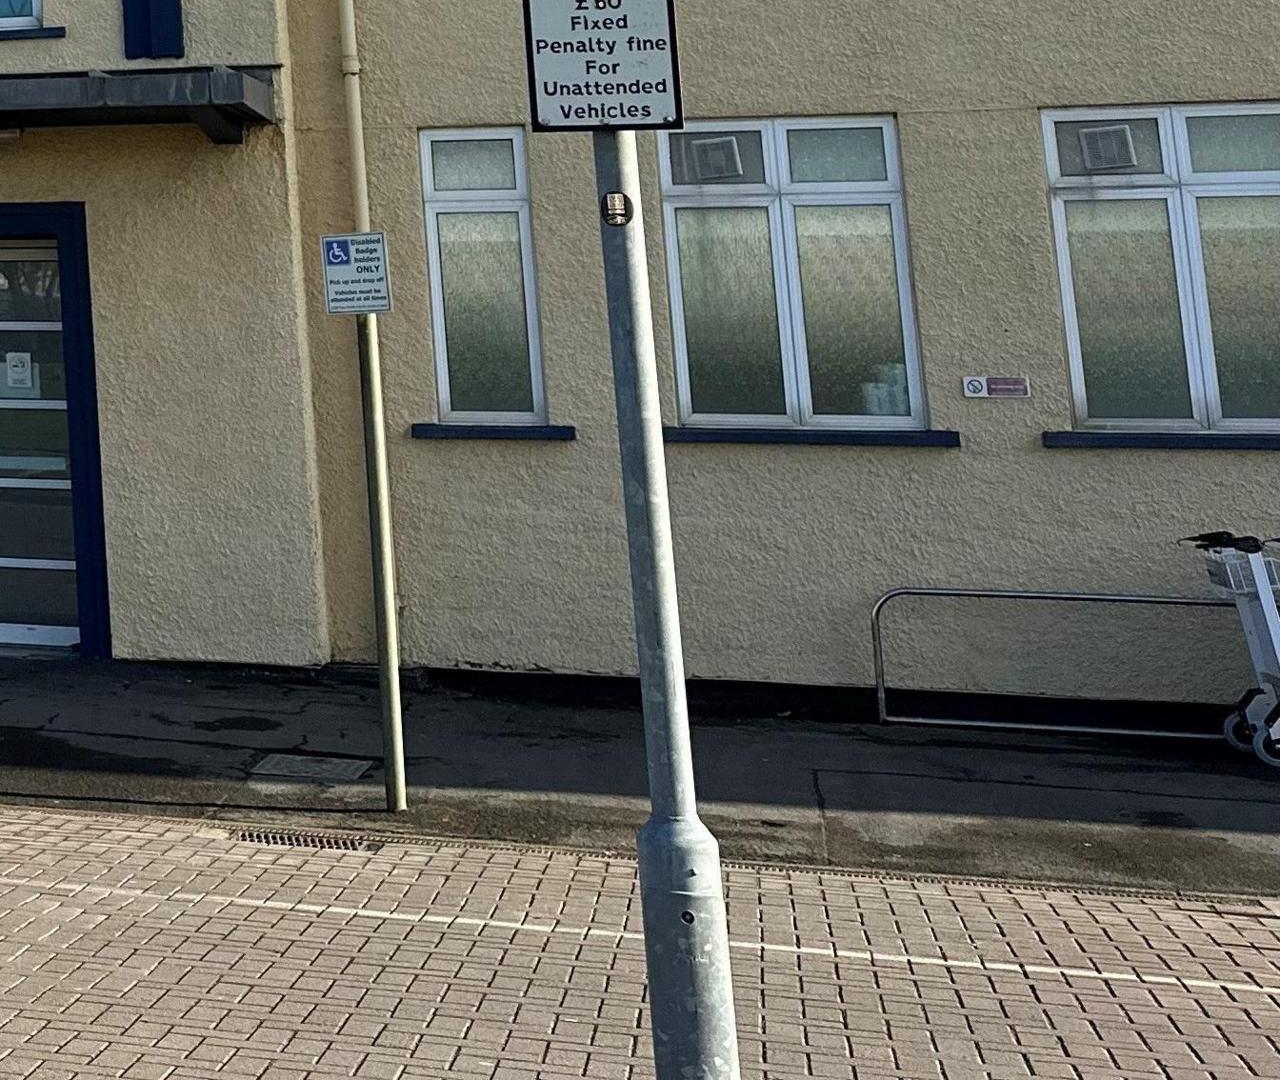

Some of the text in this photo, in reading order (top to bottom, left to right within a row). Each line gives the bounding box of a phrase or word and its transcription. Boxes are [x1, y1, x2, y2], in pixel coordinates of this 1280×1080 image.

[571, 14, 628, 31] Fixed
[536, 36, 667, 55] Penalty fine
[585, 60, 620, 75] For
[543, 78, 667, 96] Unattended
[559, 102, 652, 119] Vehicles
[351, 238, 380, 246] Disabled
[356, 265, 380, 273] ONLY
